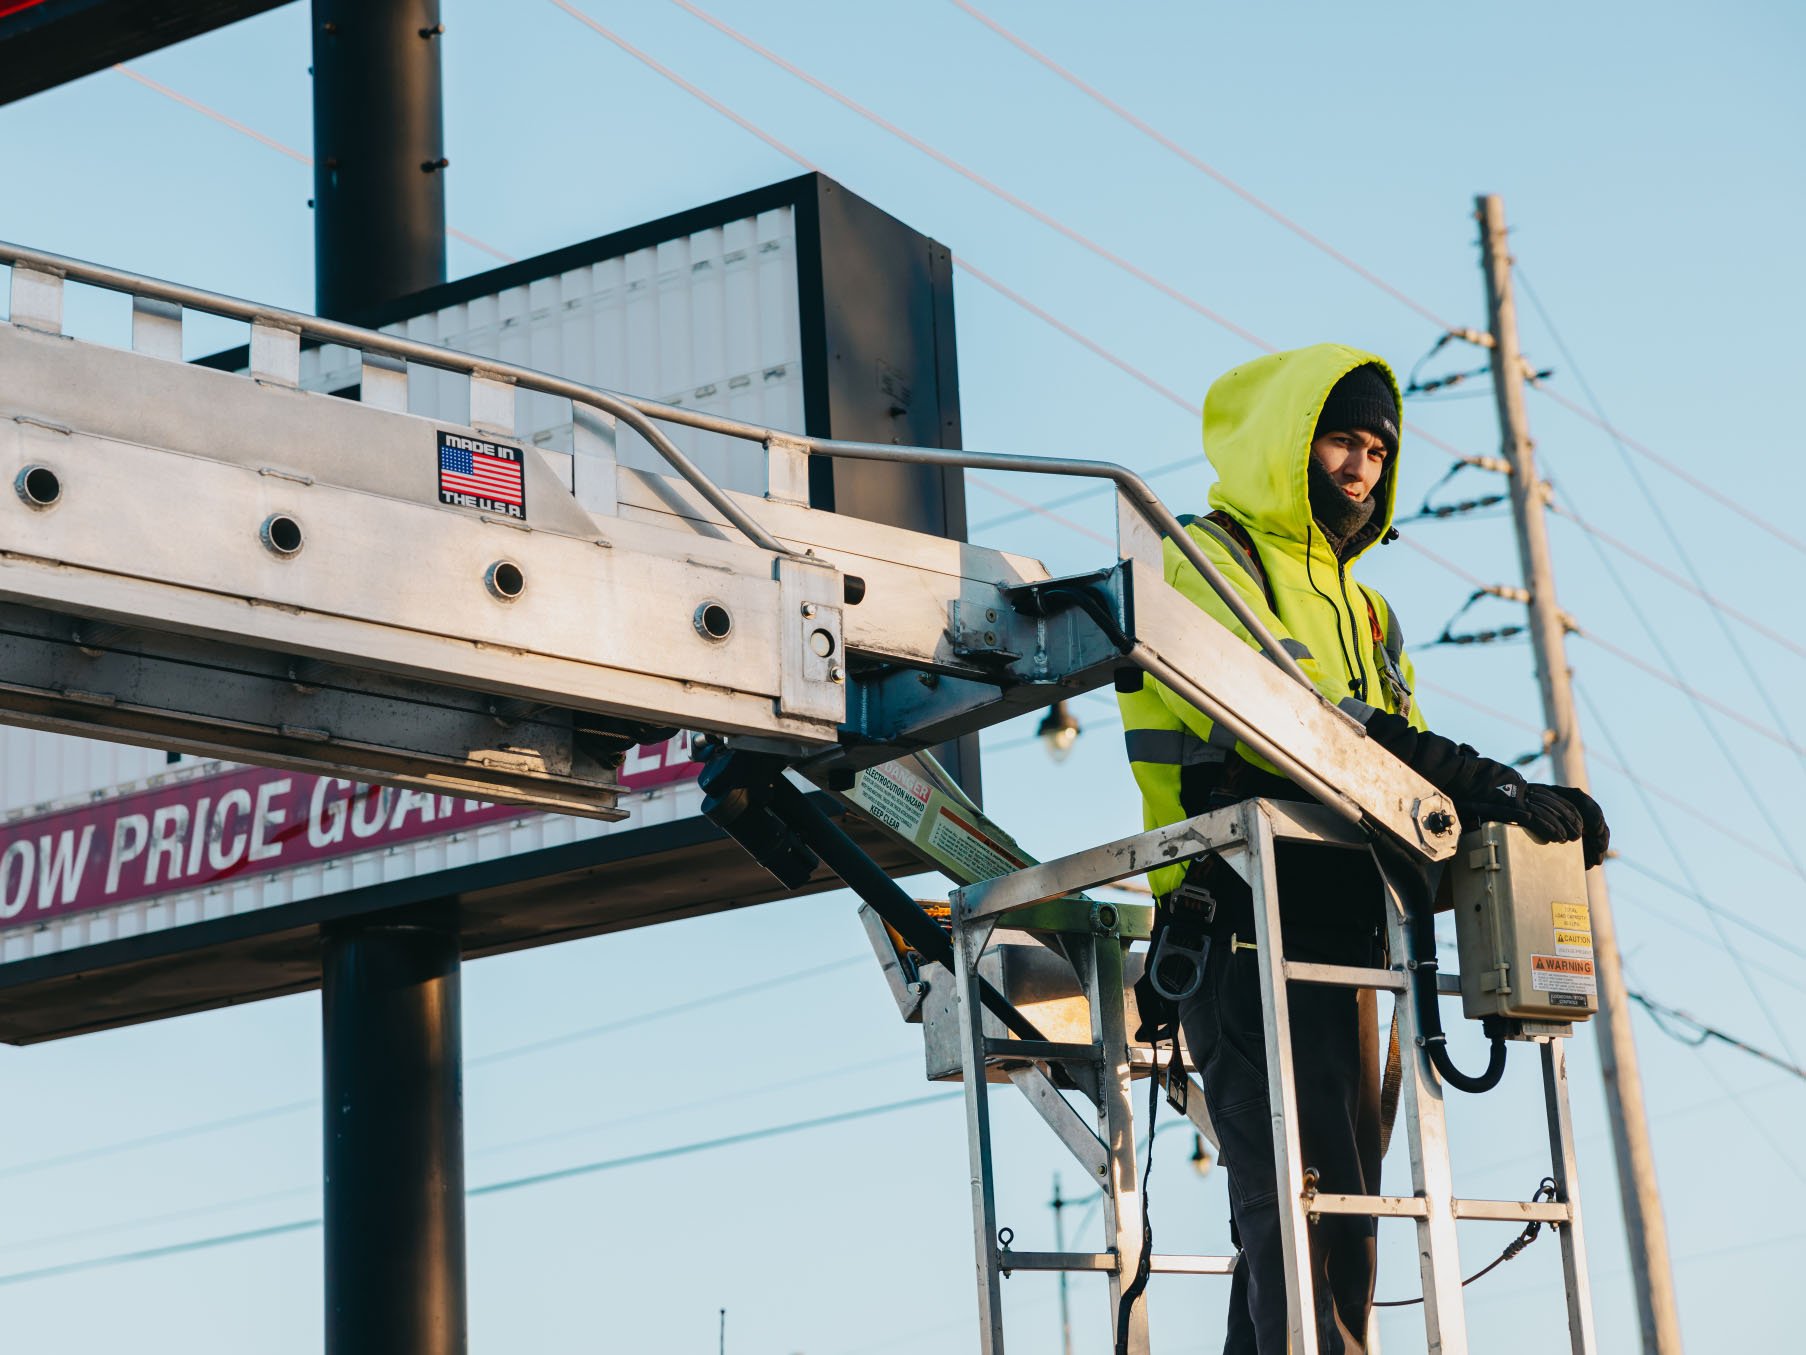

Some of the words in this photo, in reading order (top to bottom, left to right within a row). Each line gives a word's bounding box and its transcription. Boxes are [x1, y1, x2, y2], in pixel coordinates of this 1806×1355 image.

[445, 434, 495, 455] MADE
[497, 447, 514, 460] IN
[442, 490, 477, 508] THE
[479, 499, 524, 518] U.S.A.
[865, 767, 905, 798] ELECTROCUTION
[905, 792, 925, 812] HAZARD
[884, 761, 929, 799] DANGER
[869, 804, 884, 819] KEEP
[883, 814, 900, 830] CLEAR
[105, 777, 293, 894] PRICE
[1564, 935, 1591, 944] CAUTION
[1546, 959, 1591, 973] WARNING
